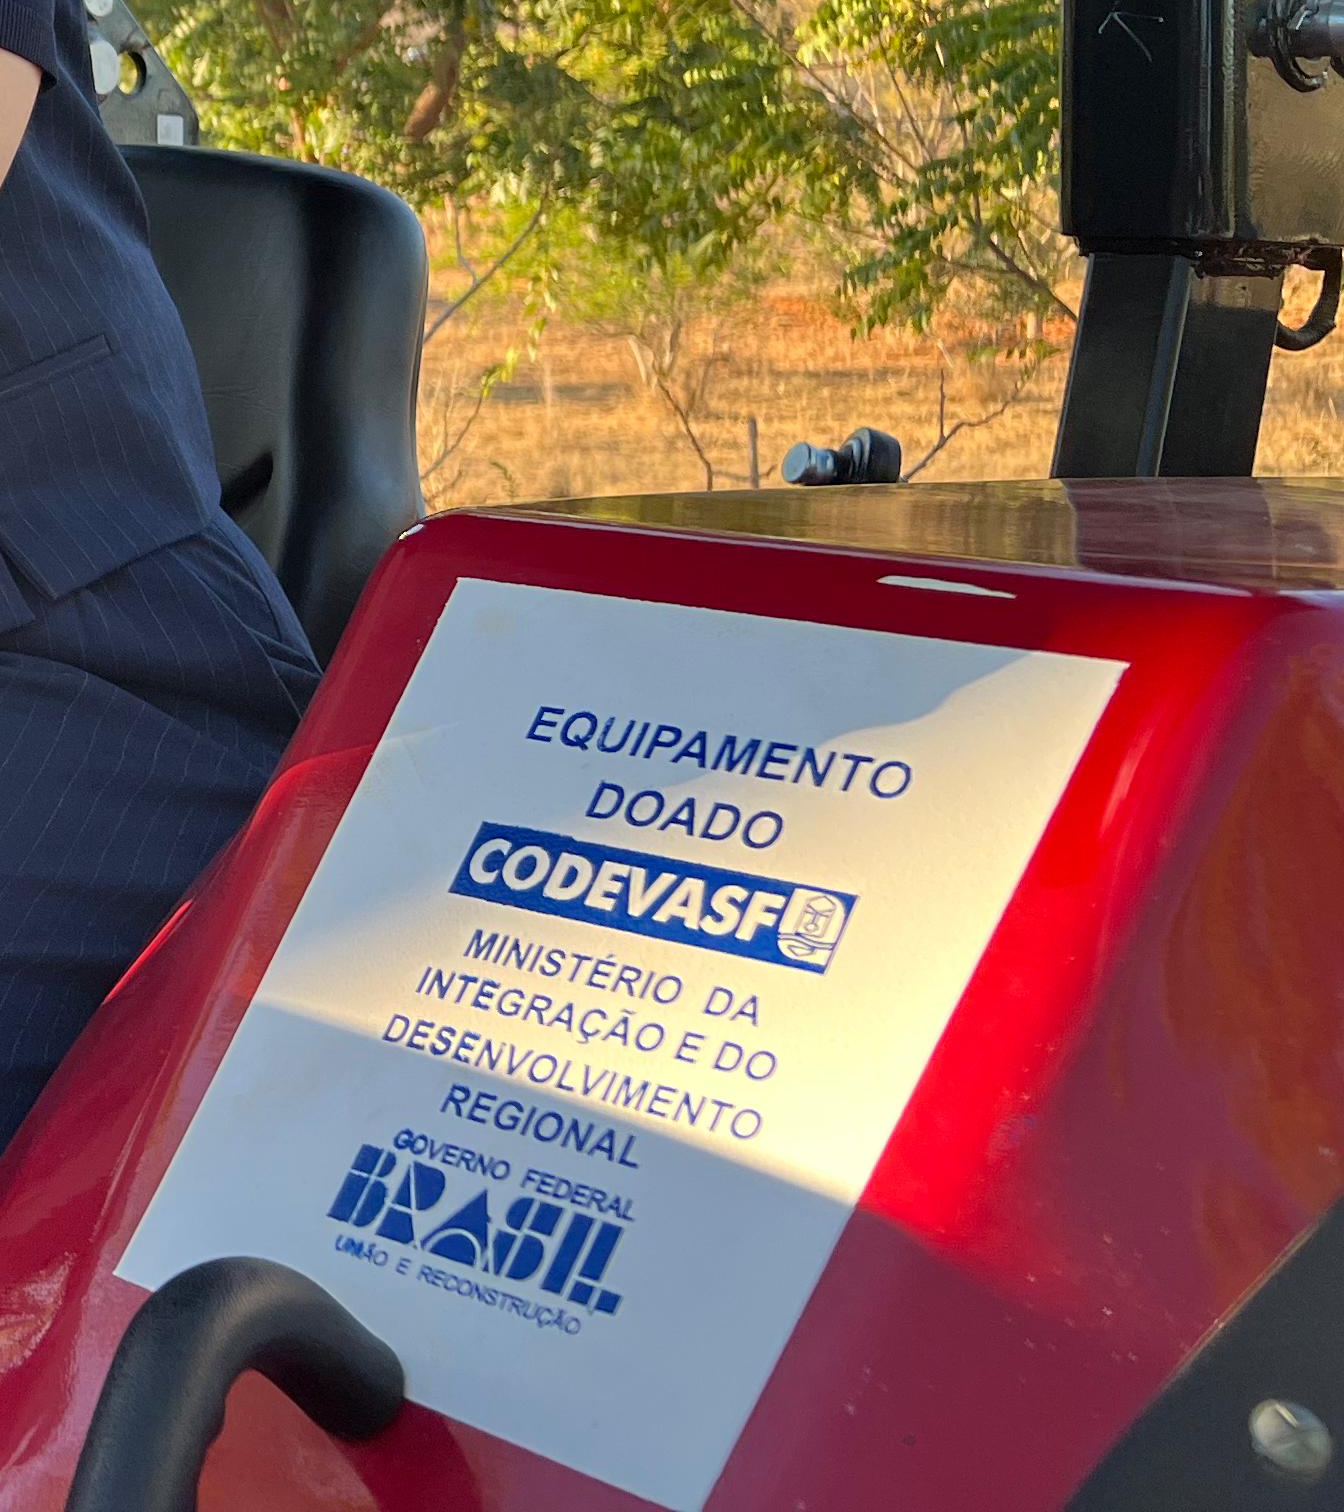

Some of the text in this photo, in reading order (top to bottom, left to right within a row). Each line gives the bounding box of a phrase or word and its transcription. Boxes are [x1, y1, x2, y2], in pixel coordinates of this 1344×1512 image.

[525, 705, 913, 800] EQUIPAMENTO
[585, 779, 785, 850] DOADO
[467, 836, 786, 942] CODEVASF
[415, 966, 778, 1081] INTEGRAÇÃO E DO
[463, 928, 761, 1027] MINISTÉRIO DA
[382, 1013, 763, 1140] DESENVOLVIMENTO
[392, 1127, 635, 1222] GOVERNO FEDERAL
[439, 1083, 639, 1170] REGIONAL
[325, 1143, 625, 1316] BRASIL
[395, 1258, 412, 1276] E
[416, 1264, 583, 1336] RECONSTRUÇÃO
